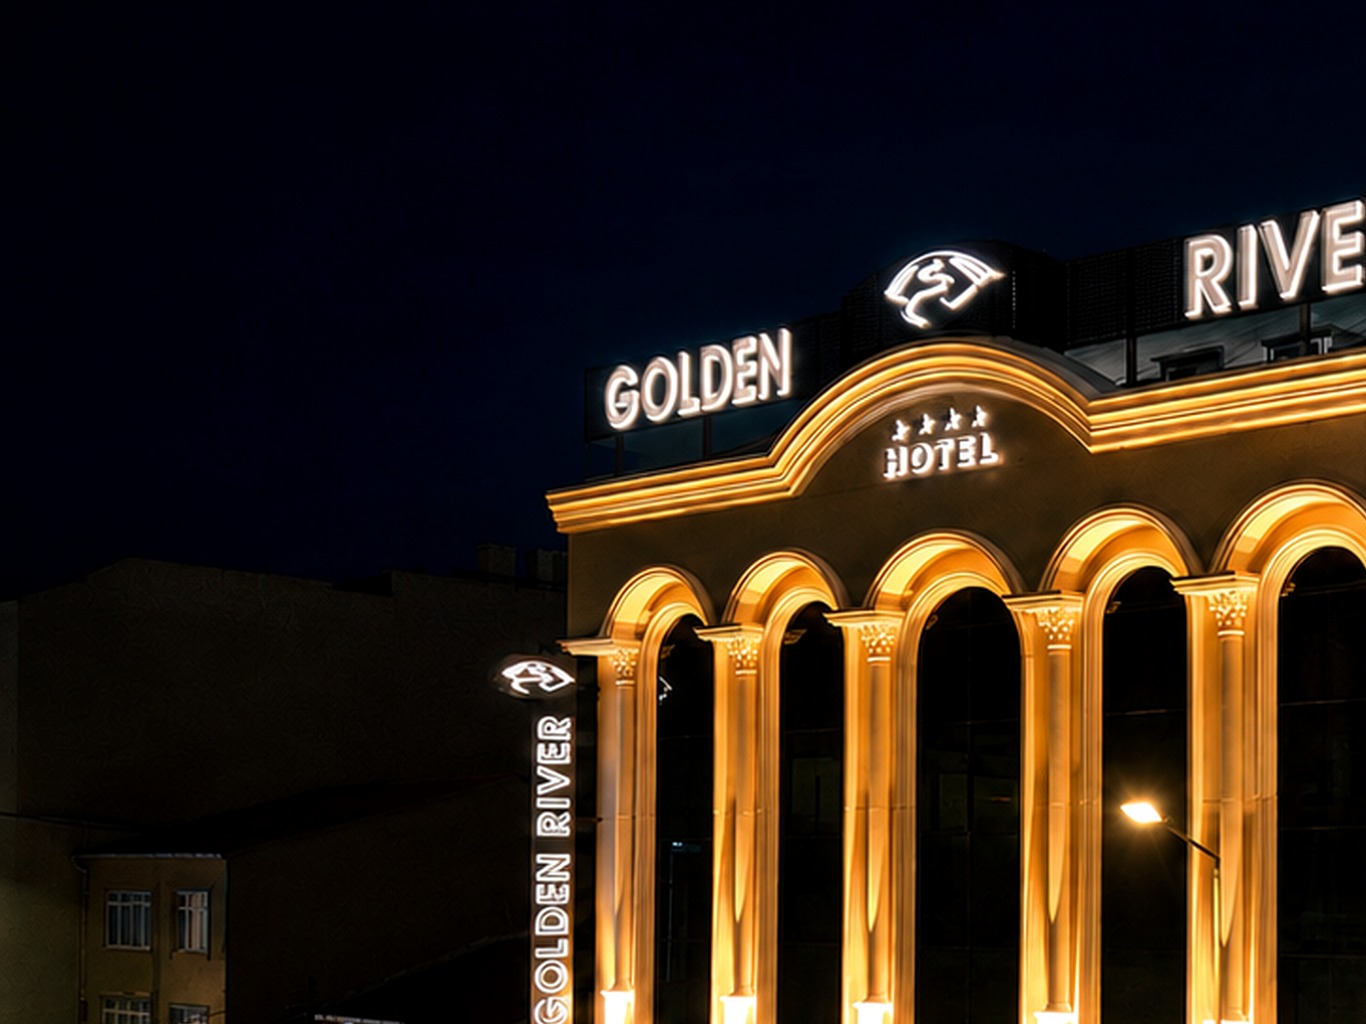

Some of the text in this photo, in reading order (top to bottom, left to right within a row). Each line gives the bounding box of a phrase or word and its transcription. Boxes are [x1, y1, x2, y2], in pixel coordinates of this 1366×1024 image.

[604, 326, 793, 430] GOLDEN
[882, 431, 1002, 481] HOTEL
[536, 714, 572, 838] RIVER
